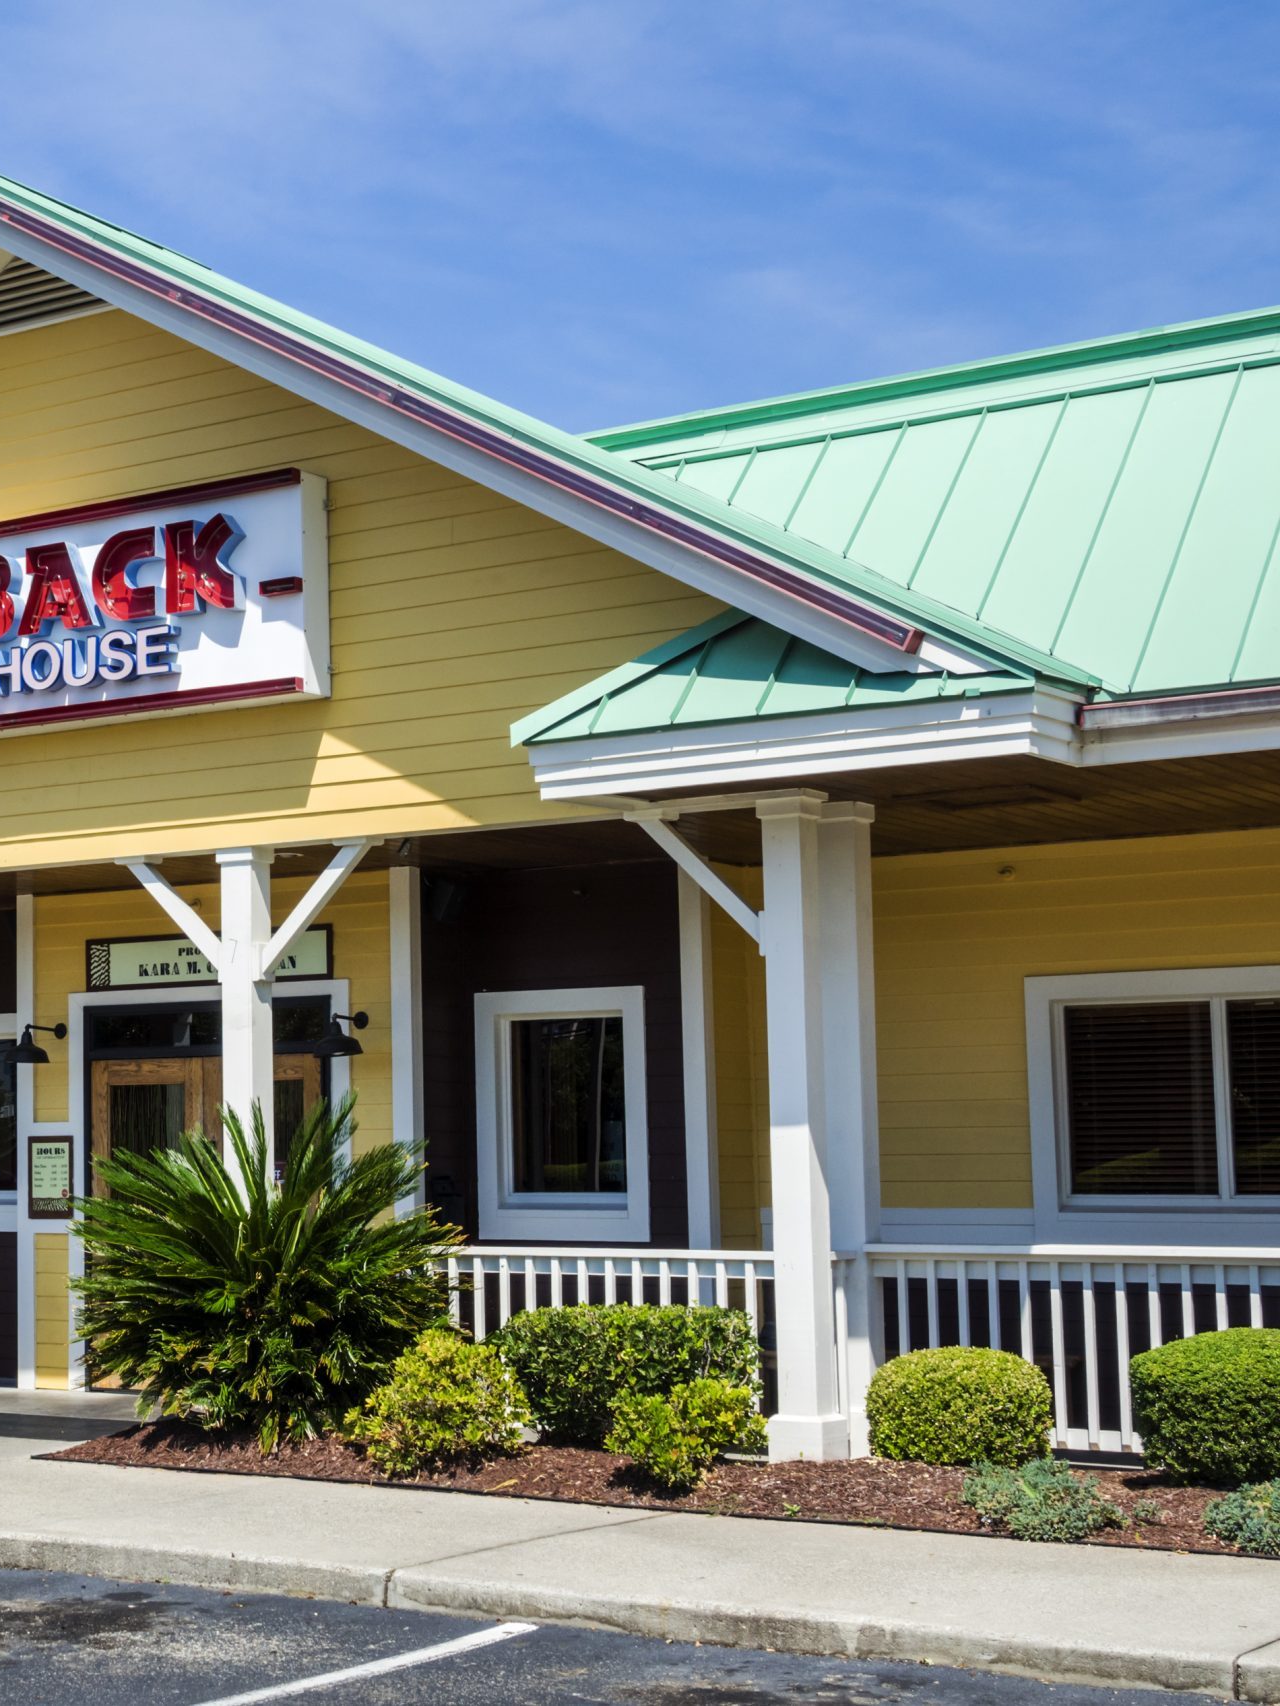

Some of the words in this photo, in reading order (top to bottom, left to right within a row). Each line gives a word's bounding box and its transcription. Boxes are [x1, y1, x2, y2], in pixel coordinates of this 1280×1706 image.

[138, 962, 180, 977] KARA
[186, 961, 201, 975] M.
[36, 1147, 66, 1155] HOURS
